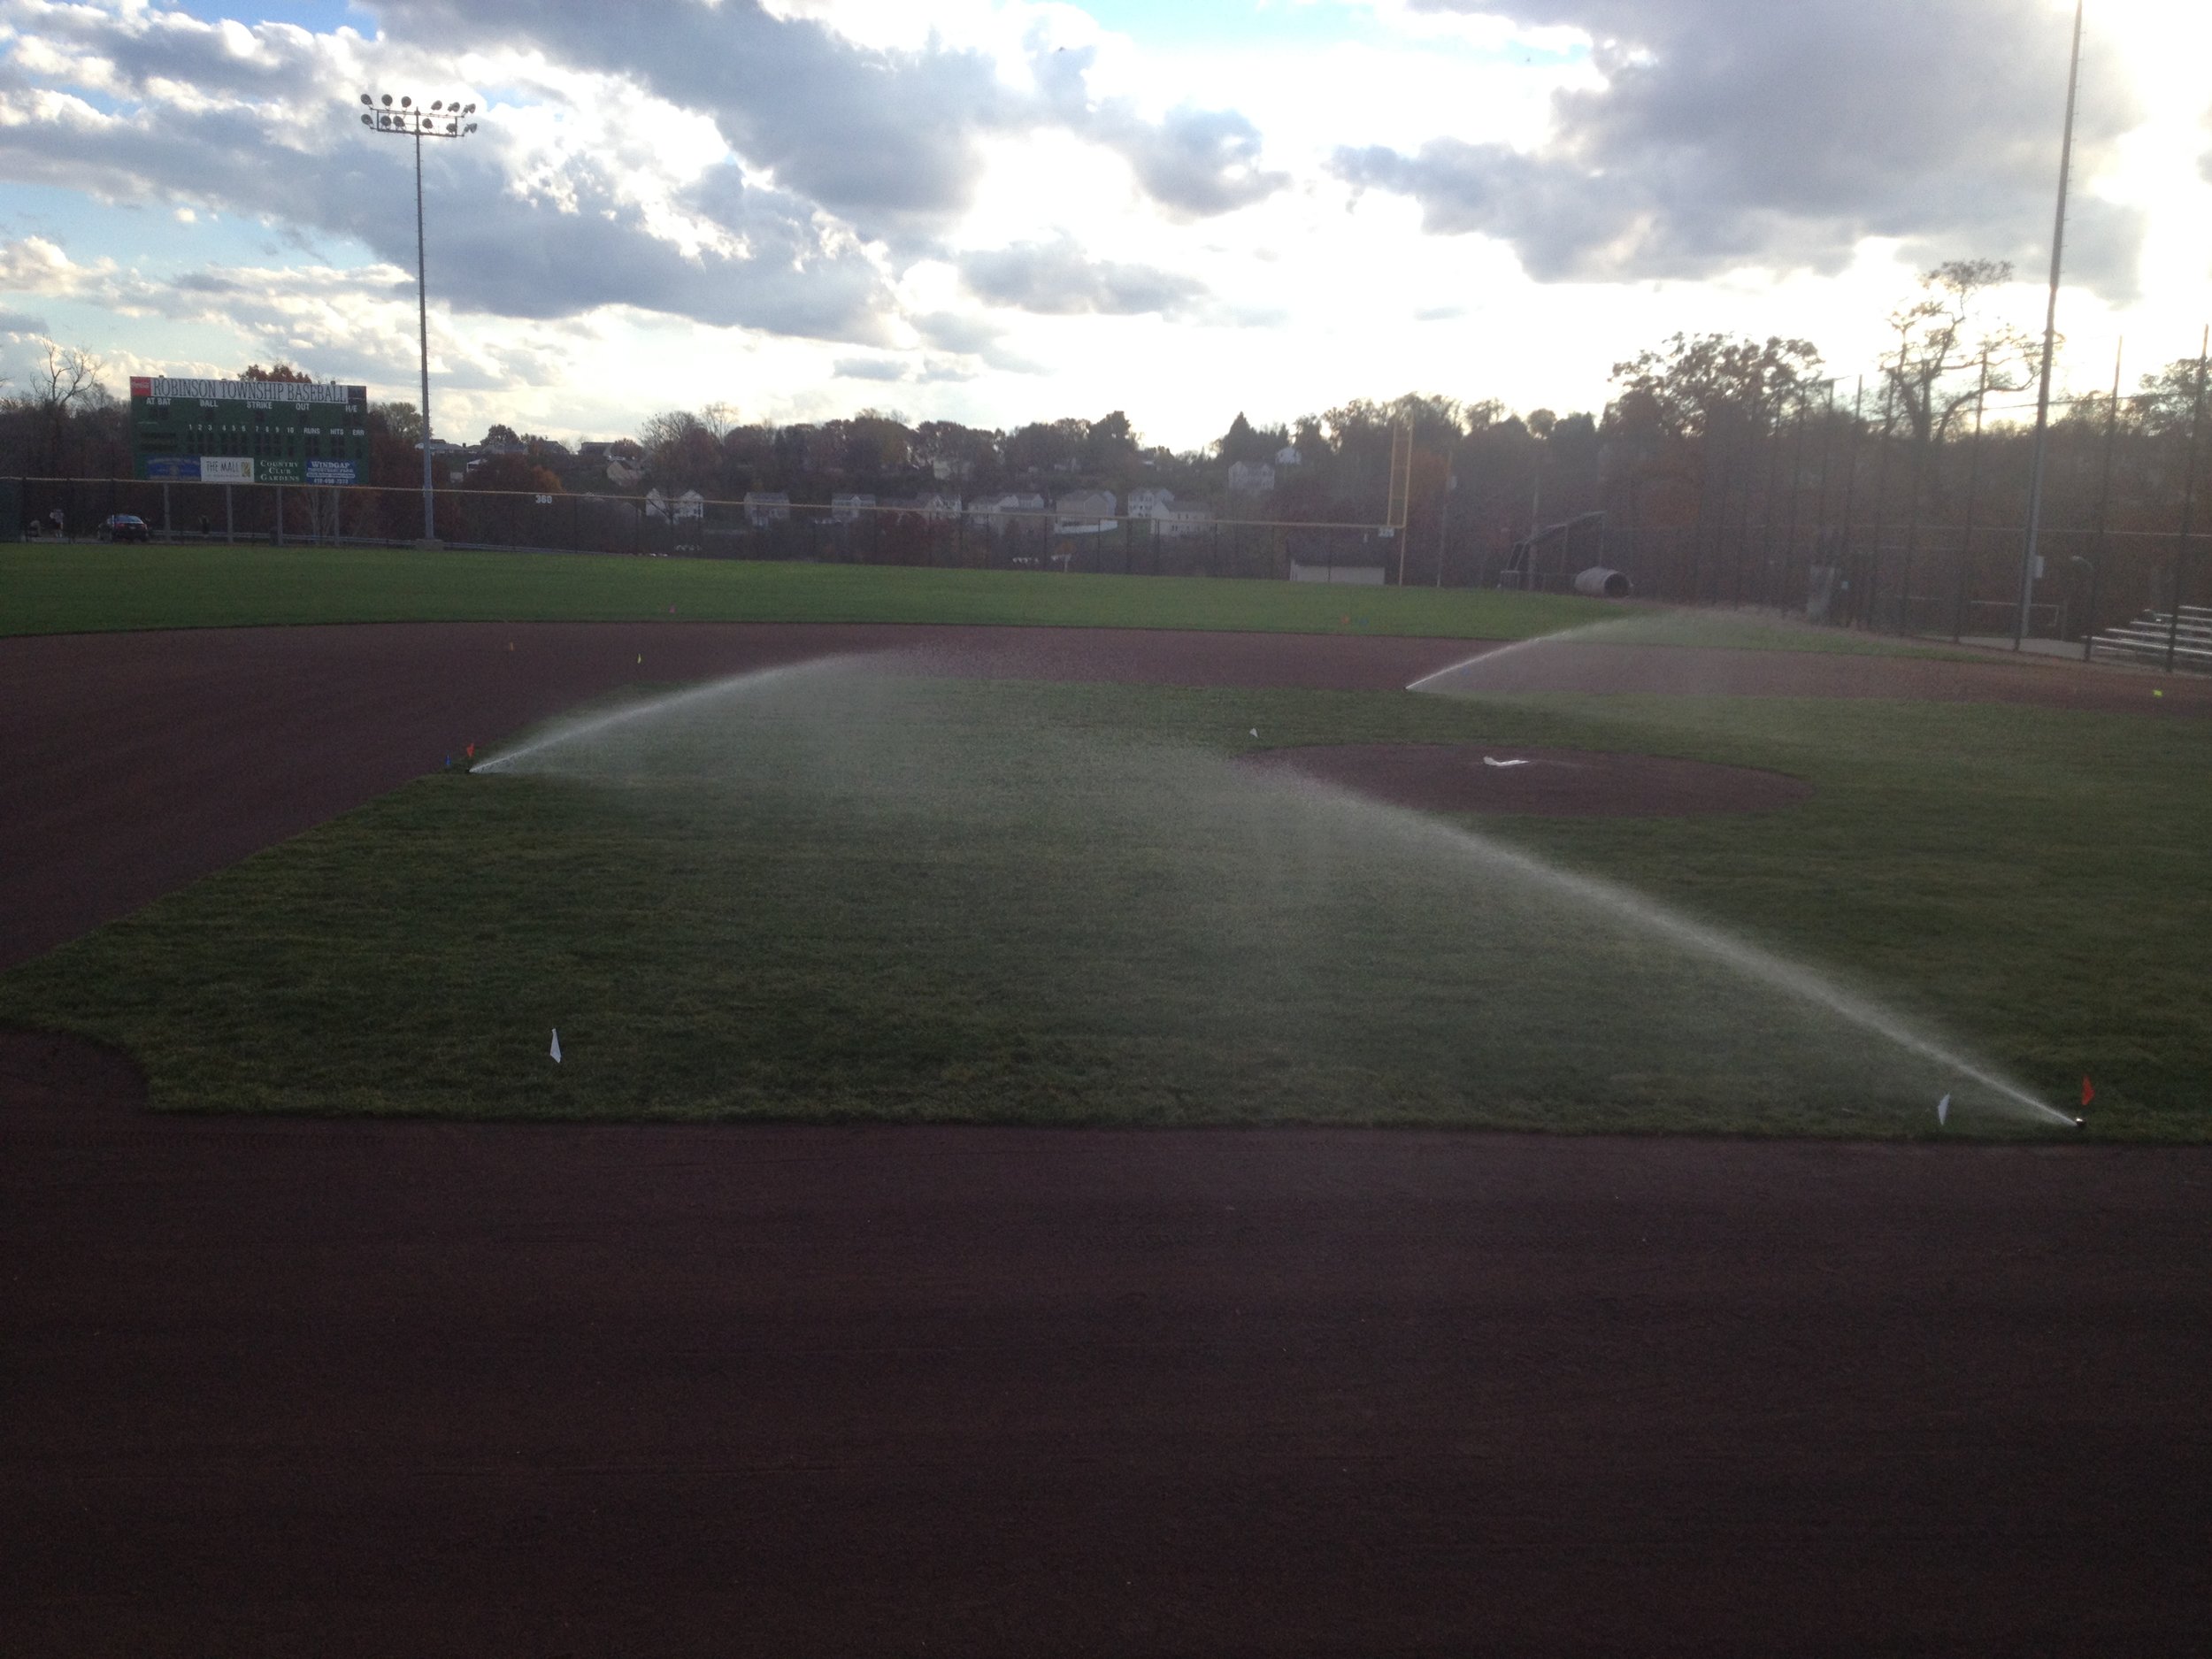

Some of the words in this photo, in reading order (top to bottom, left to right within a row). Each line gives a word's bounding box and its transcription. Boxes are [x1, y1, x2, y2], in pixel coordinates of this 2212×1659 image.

[153, 378, 216, 398] ROBINSON
[219, 380, 284, 400] TOWNSHIP
[287, 383, 347, 403] BASEBALL
[247, 401, 273, 410] STRIKE
[206, 460, 218, 472] THE
[220, 460, 239, 472] MALL
[260, 473, 300, 482] GARDENS
[535, 495, 552, 503] 360
